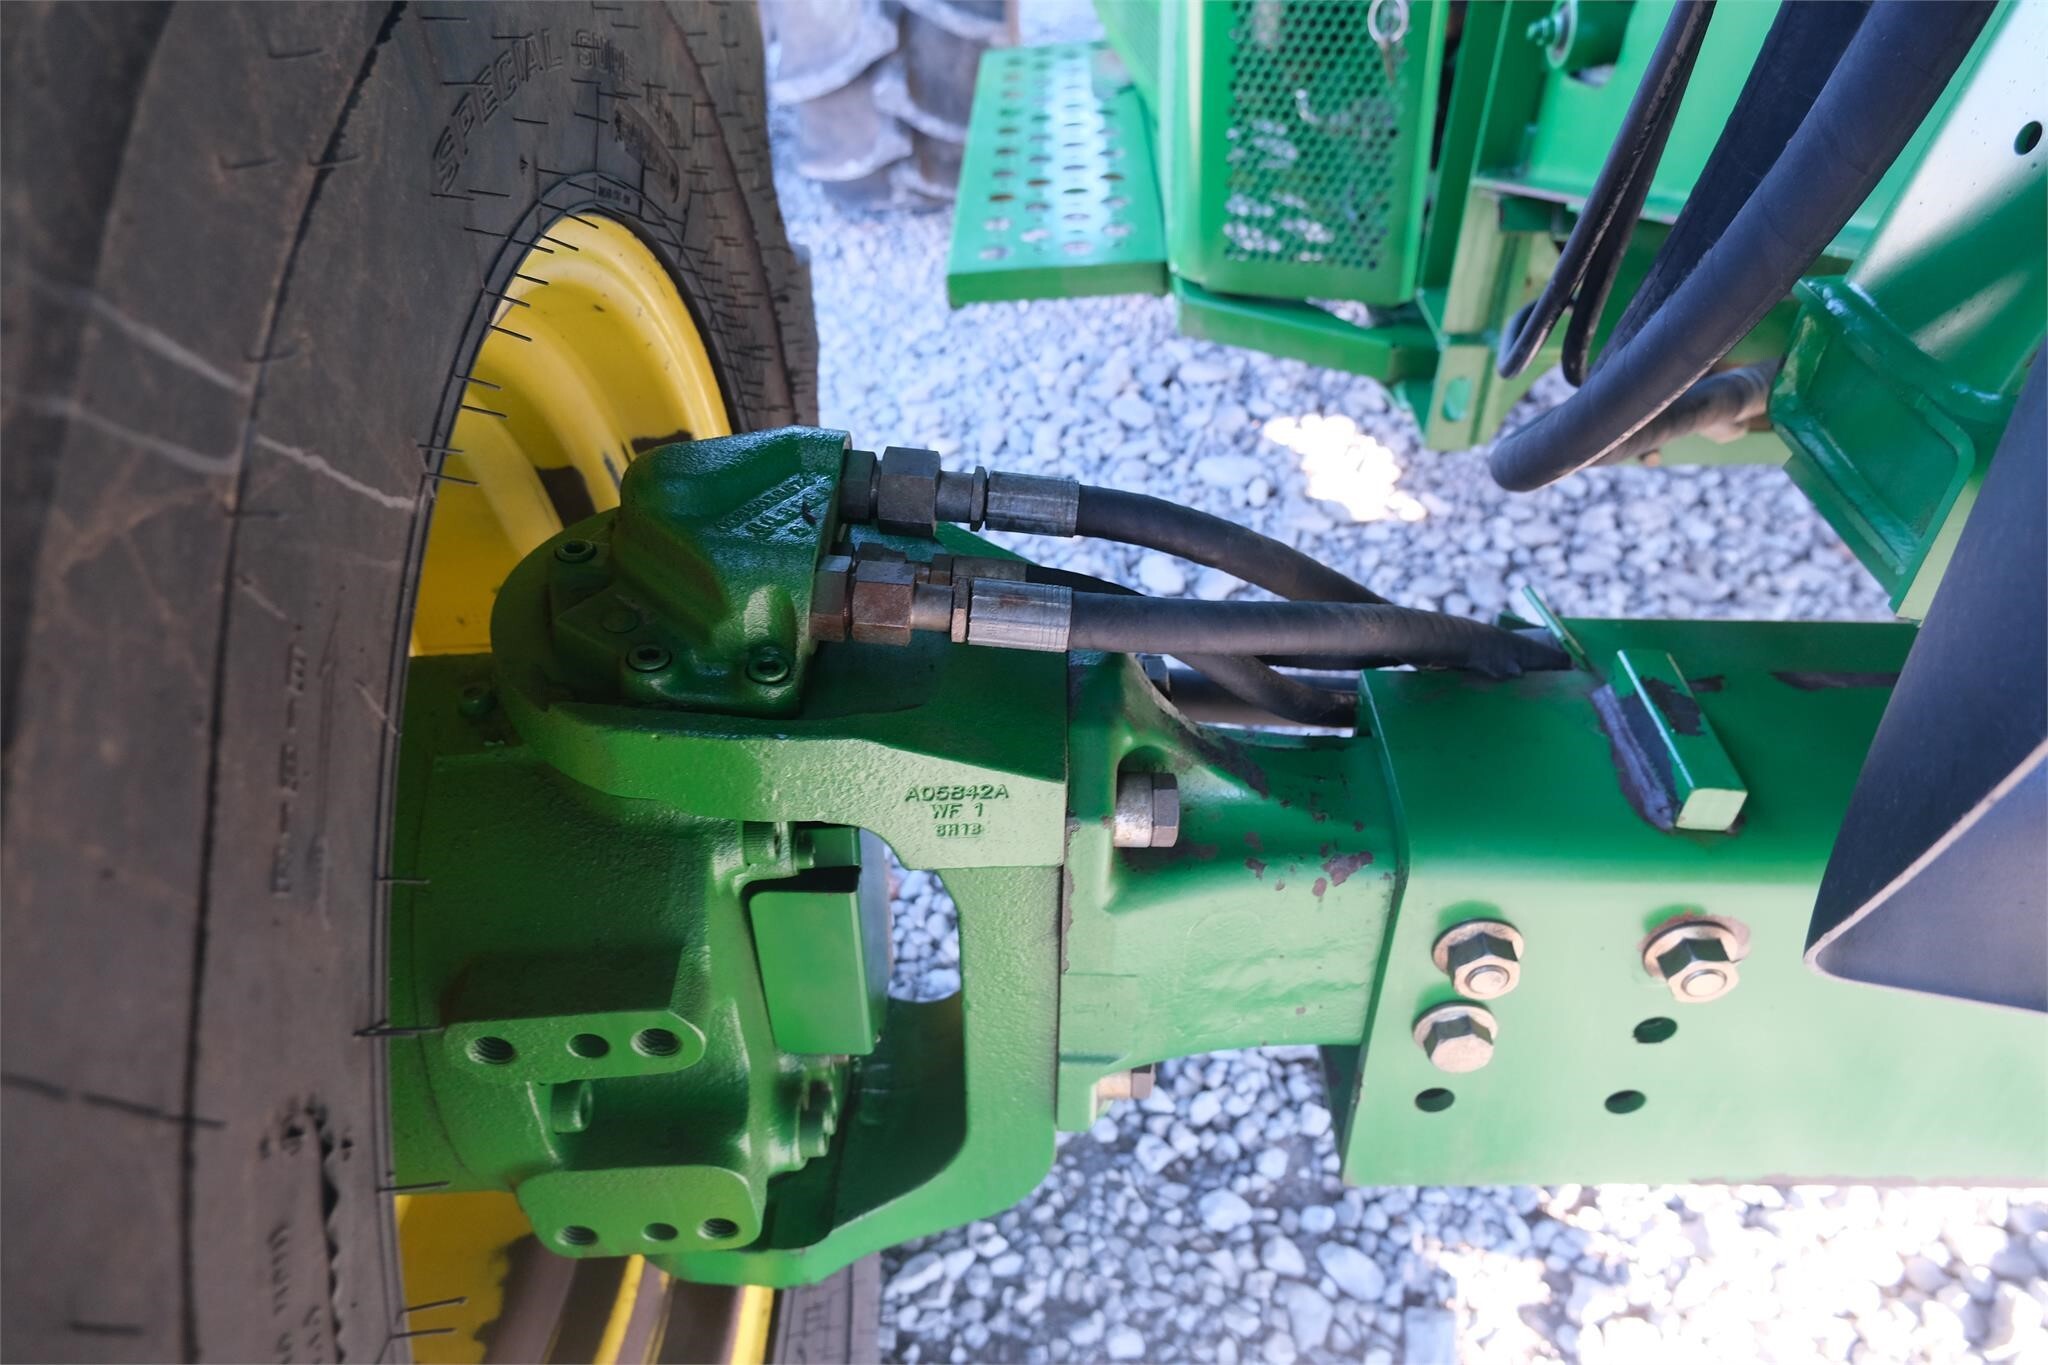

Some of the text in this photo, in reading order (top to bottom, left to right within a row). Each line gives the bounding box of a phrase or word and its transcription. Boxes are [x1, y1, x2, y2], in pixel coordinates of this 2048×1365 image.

[432, 28, 563, 193] SPECIAL
[931, 802, 984, 819] WF 1
